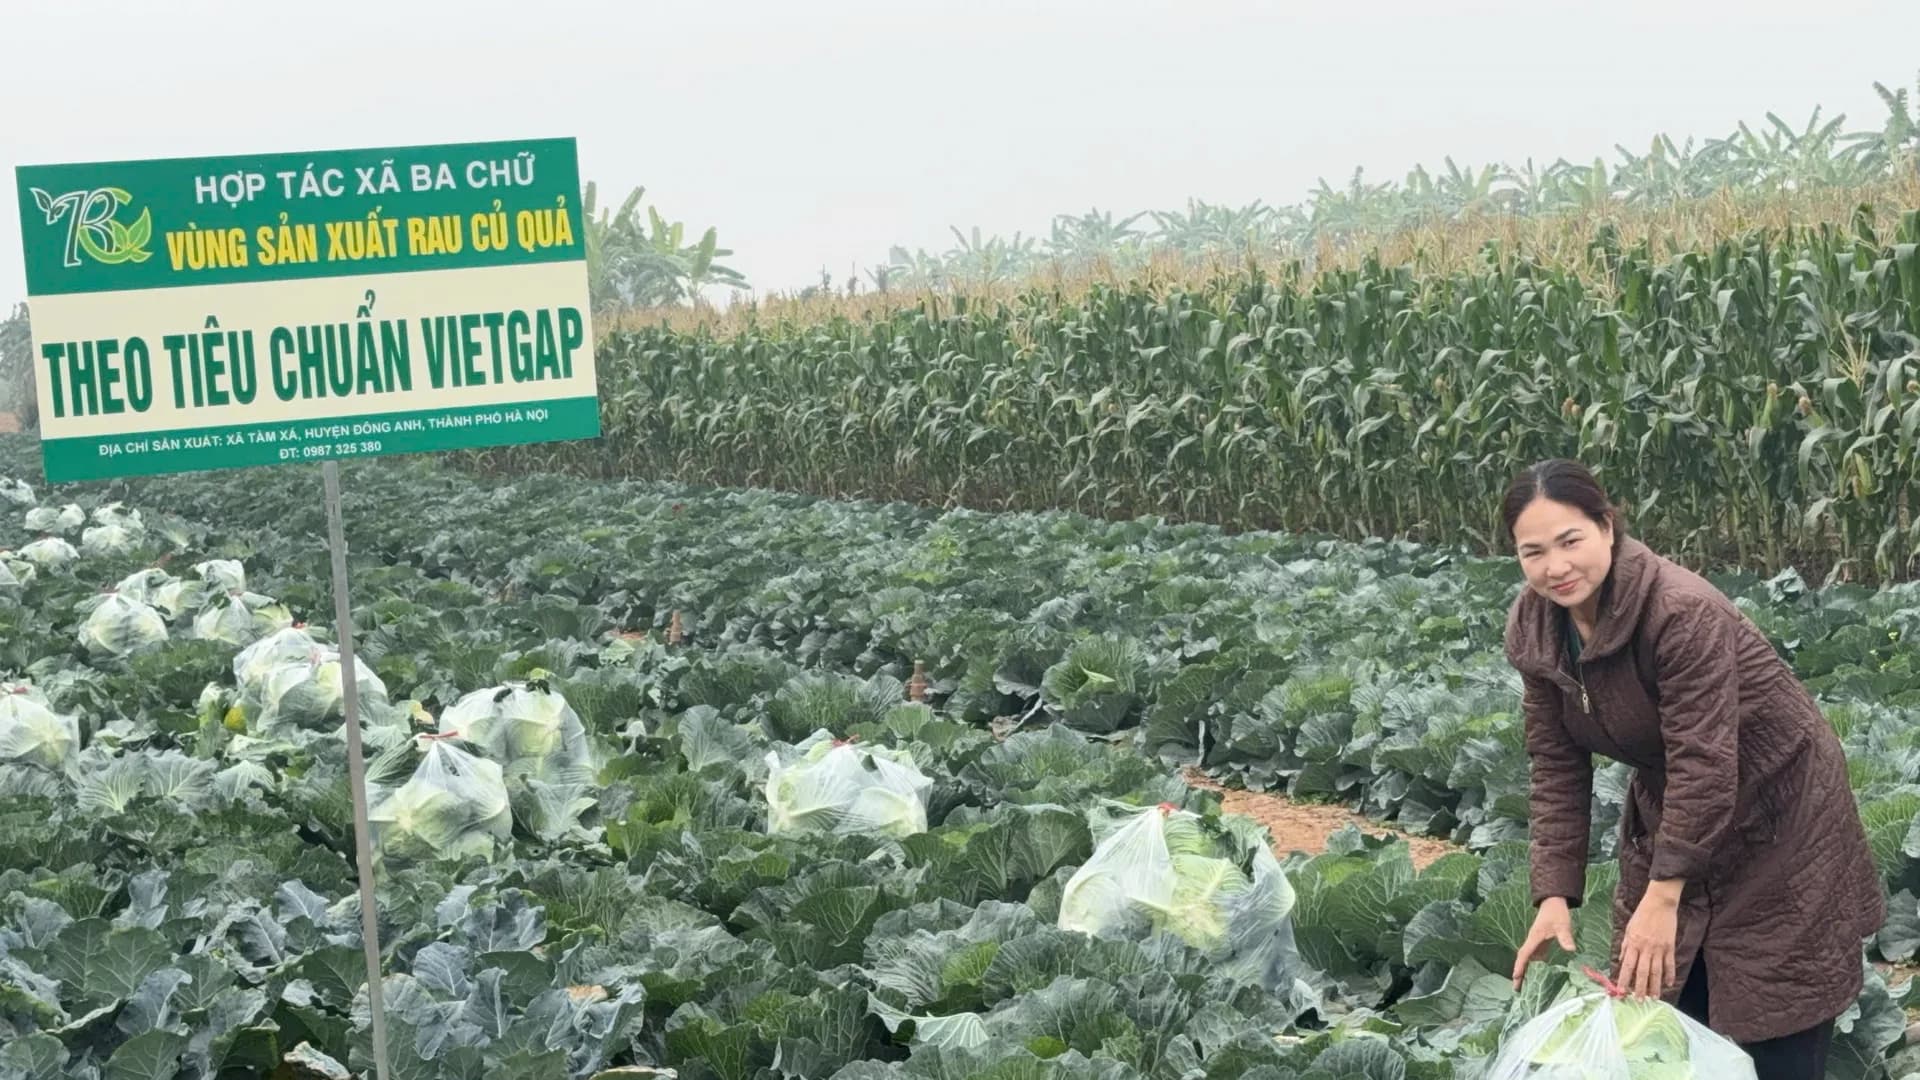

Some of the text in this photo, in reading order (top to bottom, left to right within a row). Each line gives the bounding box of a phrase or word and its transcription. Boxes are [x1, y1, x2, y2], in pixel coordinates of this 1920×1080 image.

[195, 151, 536, 208] HỢP TÁC XÃ BA CHỮ
[166, 195, 574, 271] VÙNG SẢN XUẤT RAU CỦ QUẢ
[41, 289, 583, 418] THEO TIÊU CHUẨN VIETGAP
[99, 443, 122, 457] ĐỊA
[226, 431, 245, 445] XÃ
[249, 429, 276, 443] TÀM
[305, 425, 350, 439] HUYỆN
[353, 420, 391, 435] ĐÔNG
[394, 419, 425, 432] ANH,
[427, 414, 472, 429] THÀNH
[505, 409, 523, 422] HÀ
[279, 440, 381, 459] ĐT: 0987 325 380
